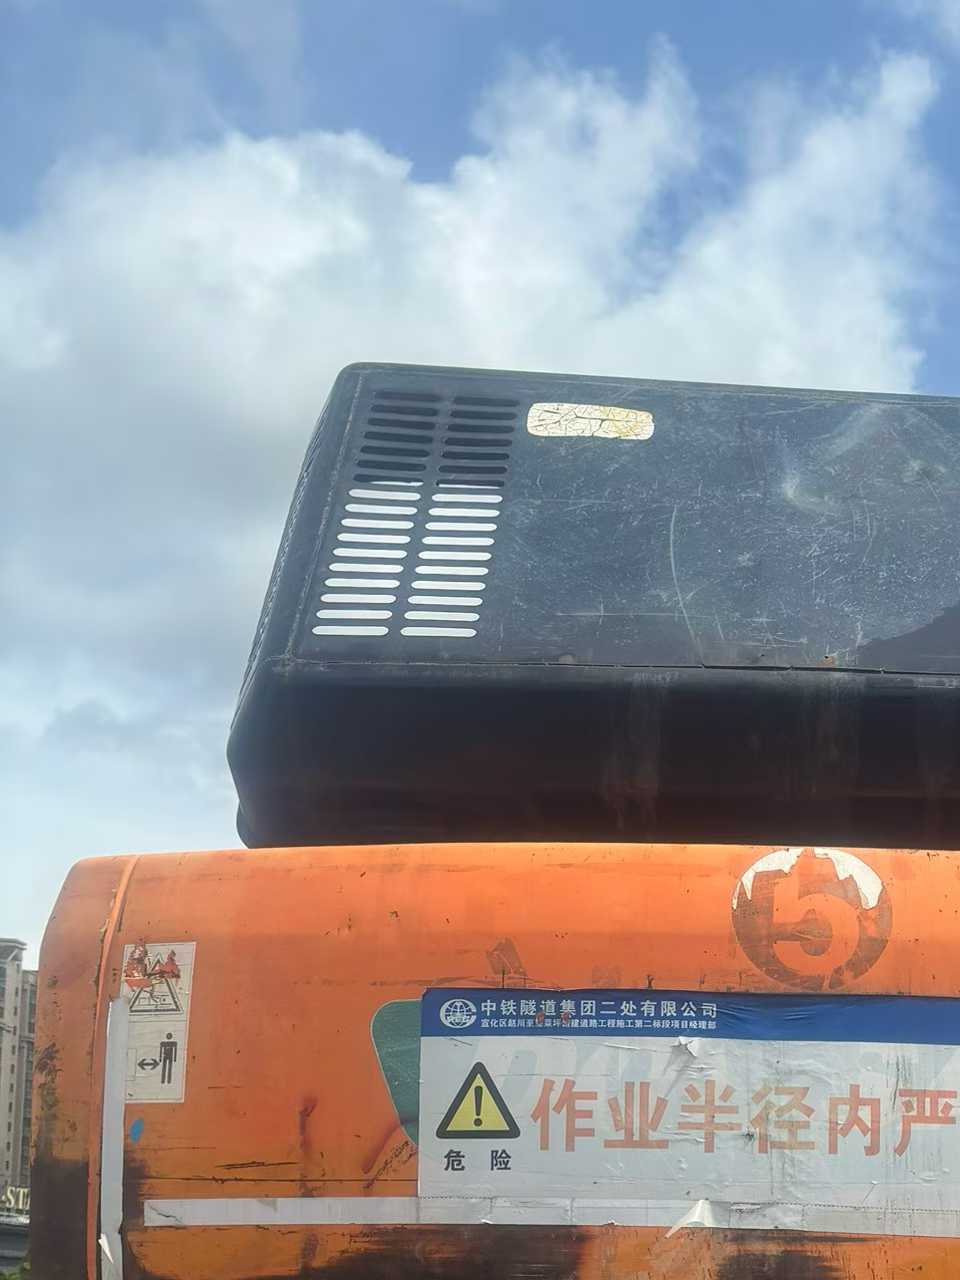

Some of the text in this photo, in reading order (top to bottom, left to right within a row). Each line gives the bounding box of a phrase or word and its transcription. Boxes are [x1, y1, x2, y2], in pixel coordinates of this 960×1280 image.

[481, 999, 718, 1018] 中铁隧道集团二处有限公司
[444, 1149, 511, 1171] 危险
